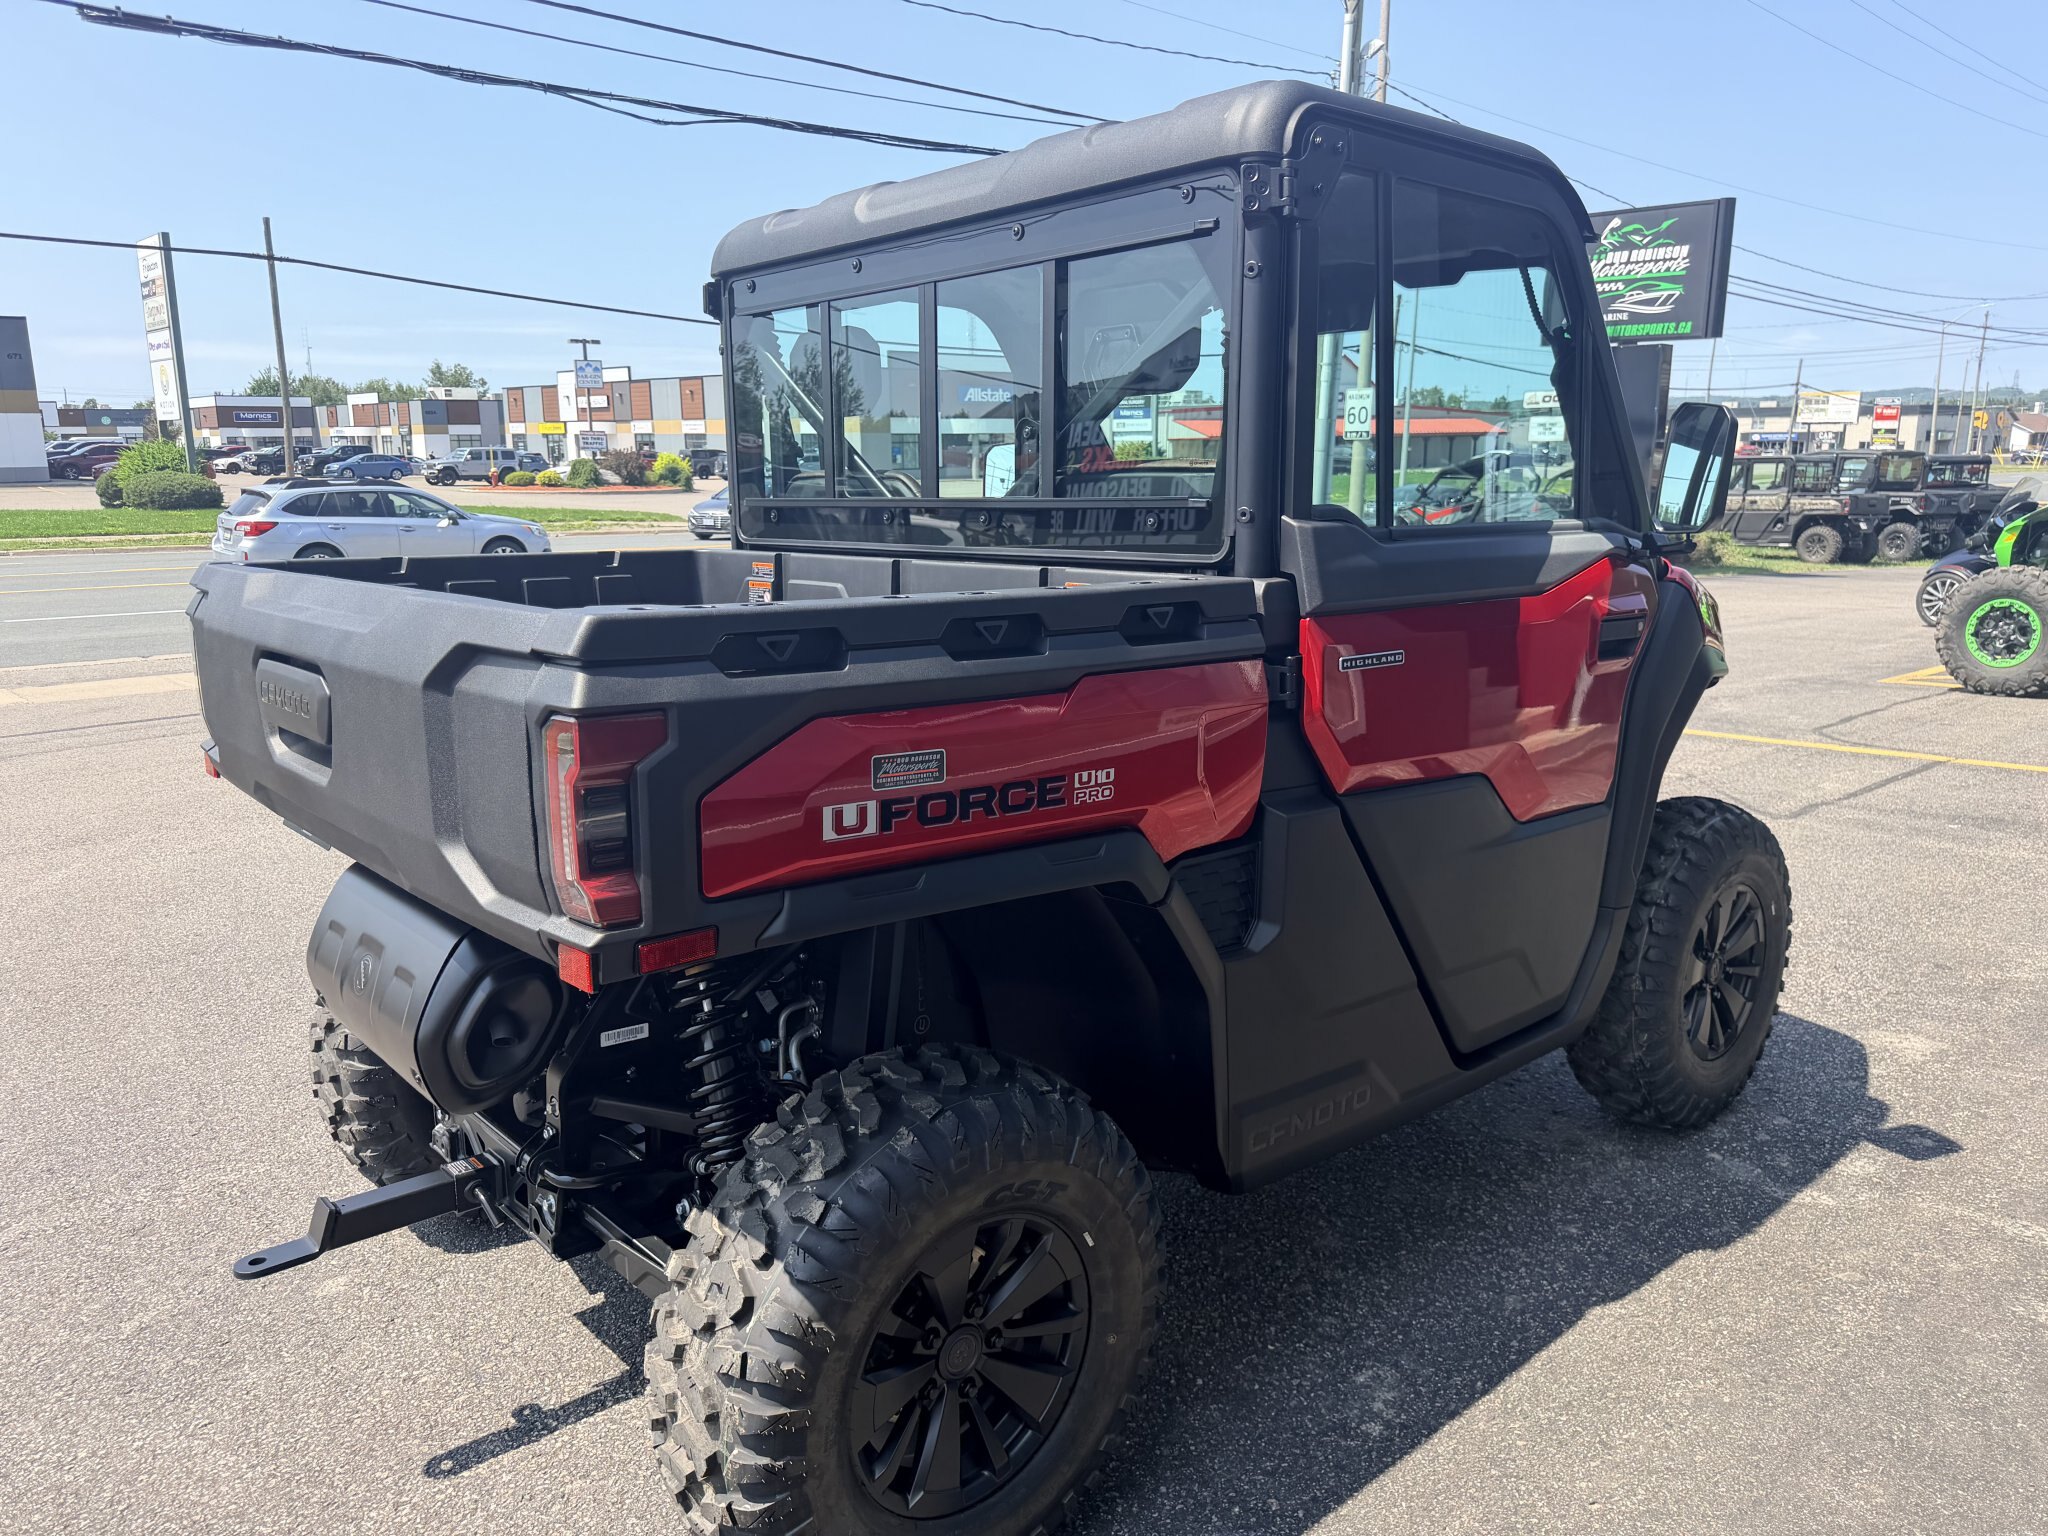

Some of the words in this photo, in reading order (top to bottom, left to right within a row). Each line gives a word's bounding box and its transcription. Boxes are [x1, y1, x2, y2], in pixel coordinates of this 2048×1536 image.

[1630, 245, 1690, 262] ROBINSON
[1604, 312, 1629, 321] ARINE
[1607, 321, 1692, 337] MOTORSPORTS.CA
[964, 387, 1012, 402] Allstate
[1347, 406, 1369, 424] 60
[1343, 655, 1402, 668] HIGHLAND
[260, 680, 311, 719] CFMOTO
[911, 753, 941, 762] ROBINSON
[877, 760, 941, 778] Motorsports
[1074, 767, 1115, 789] U10
[1074, 784, 1115, 805] PRO
[1248, 1083, 1372, 1153] CFMOTO
[983, 1180, 1069, 1208] CST
